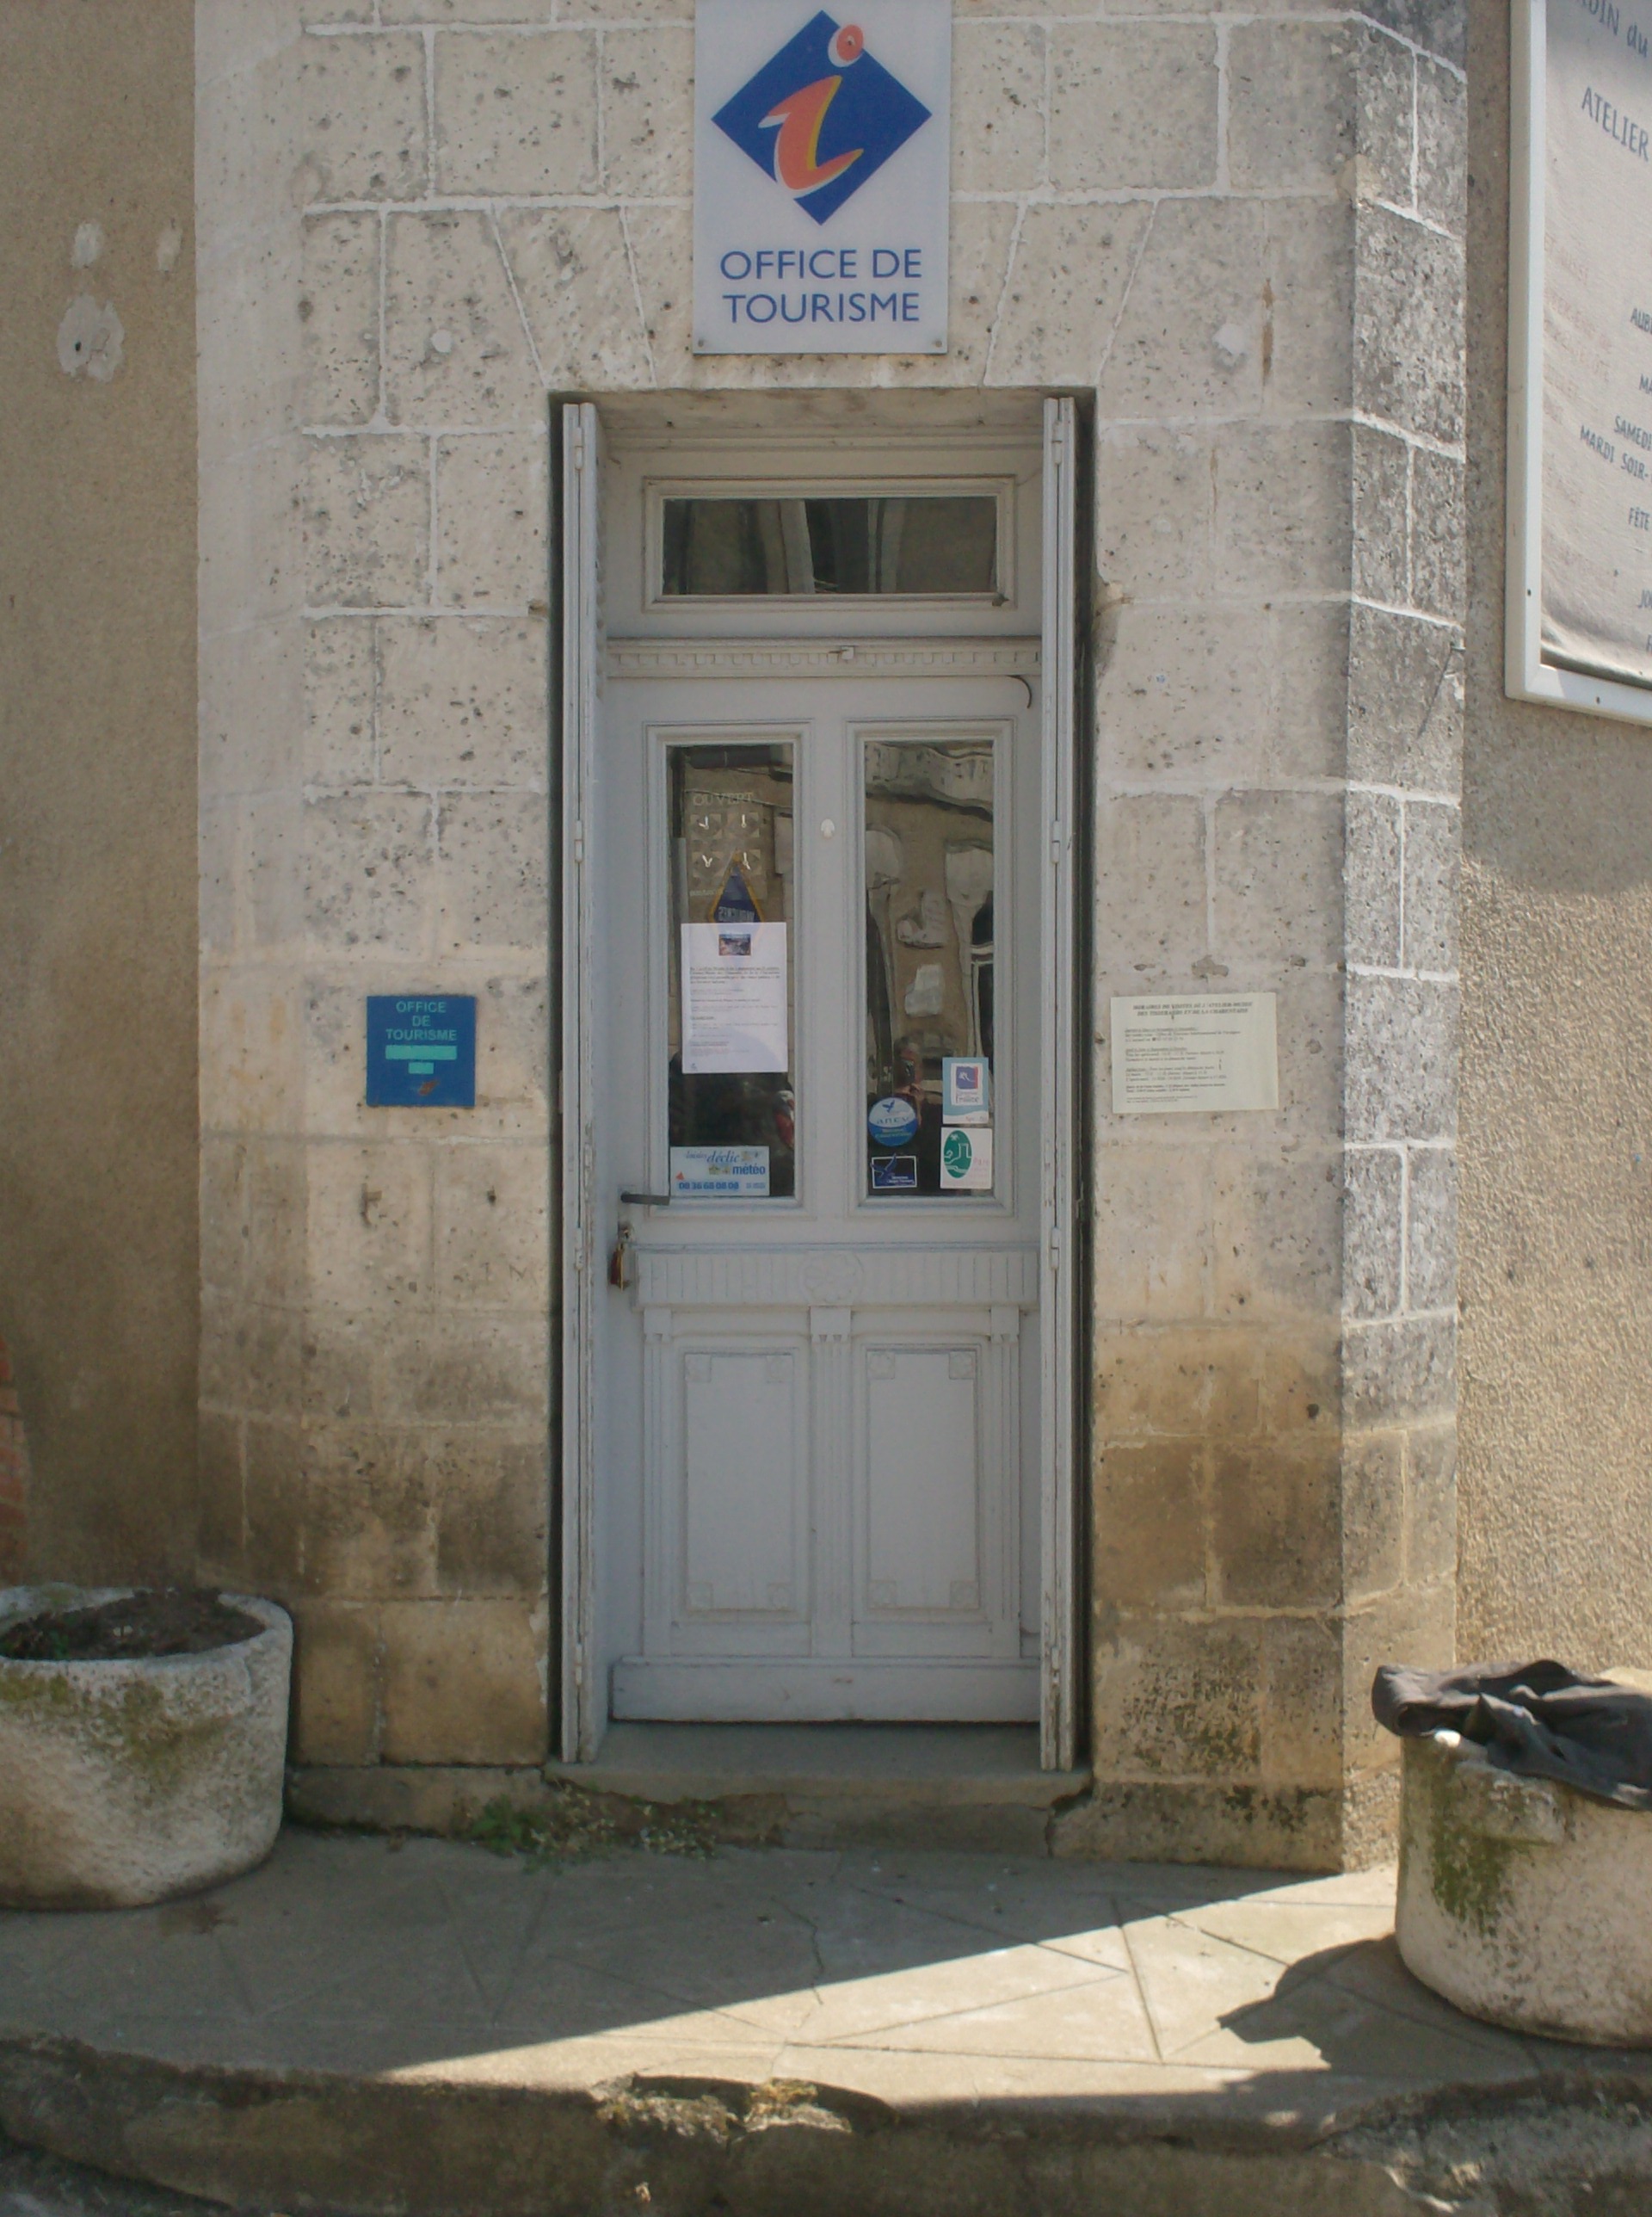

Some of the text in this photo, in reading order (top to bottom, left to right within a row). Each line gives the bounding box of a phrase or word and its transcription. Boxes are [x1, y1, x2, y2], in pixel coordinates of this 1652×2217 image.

[1576, 0, 1648, 58] DIN du
[1581, 87, 1649, 162] ATELIER
[720, 249, 922, 280] OFFICE DE
[722, 293, 920, 323] TOURISME
[1581, 425, 1615, 463] MARDI
[1614, 415, 1652, 451] SAMEDI
[1629, 506, 1651, 531] FÊTE
[396, 1001, 447, 1013] OFFICE
[412, 1016, 431, 1027] DE
[385, 1028, 458, 1041] TOURISME
[732, 1163, 766, 1175] météo
